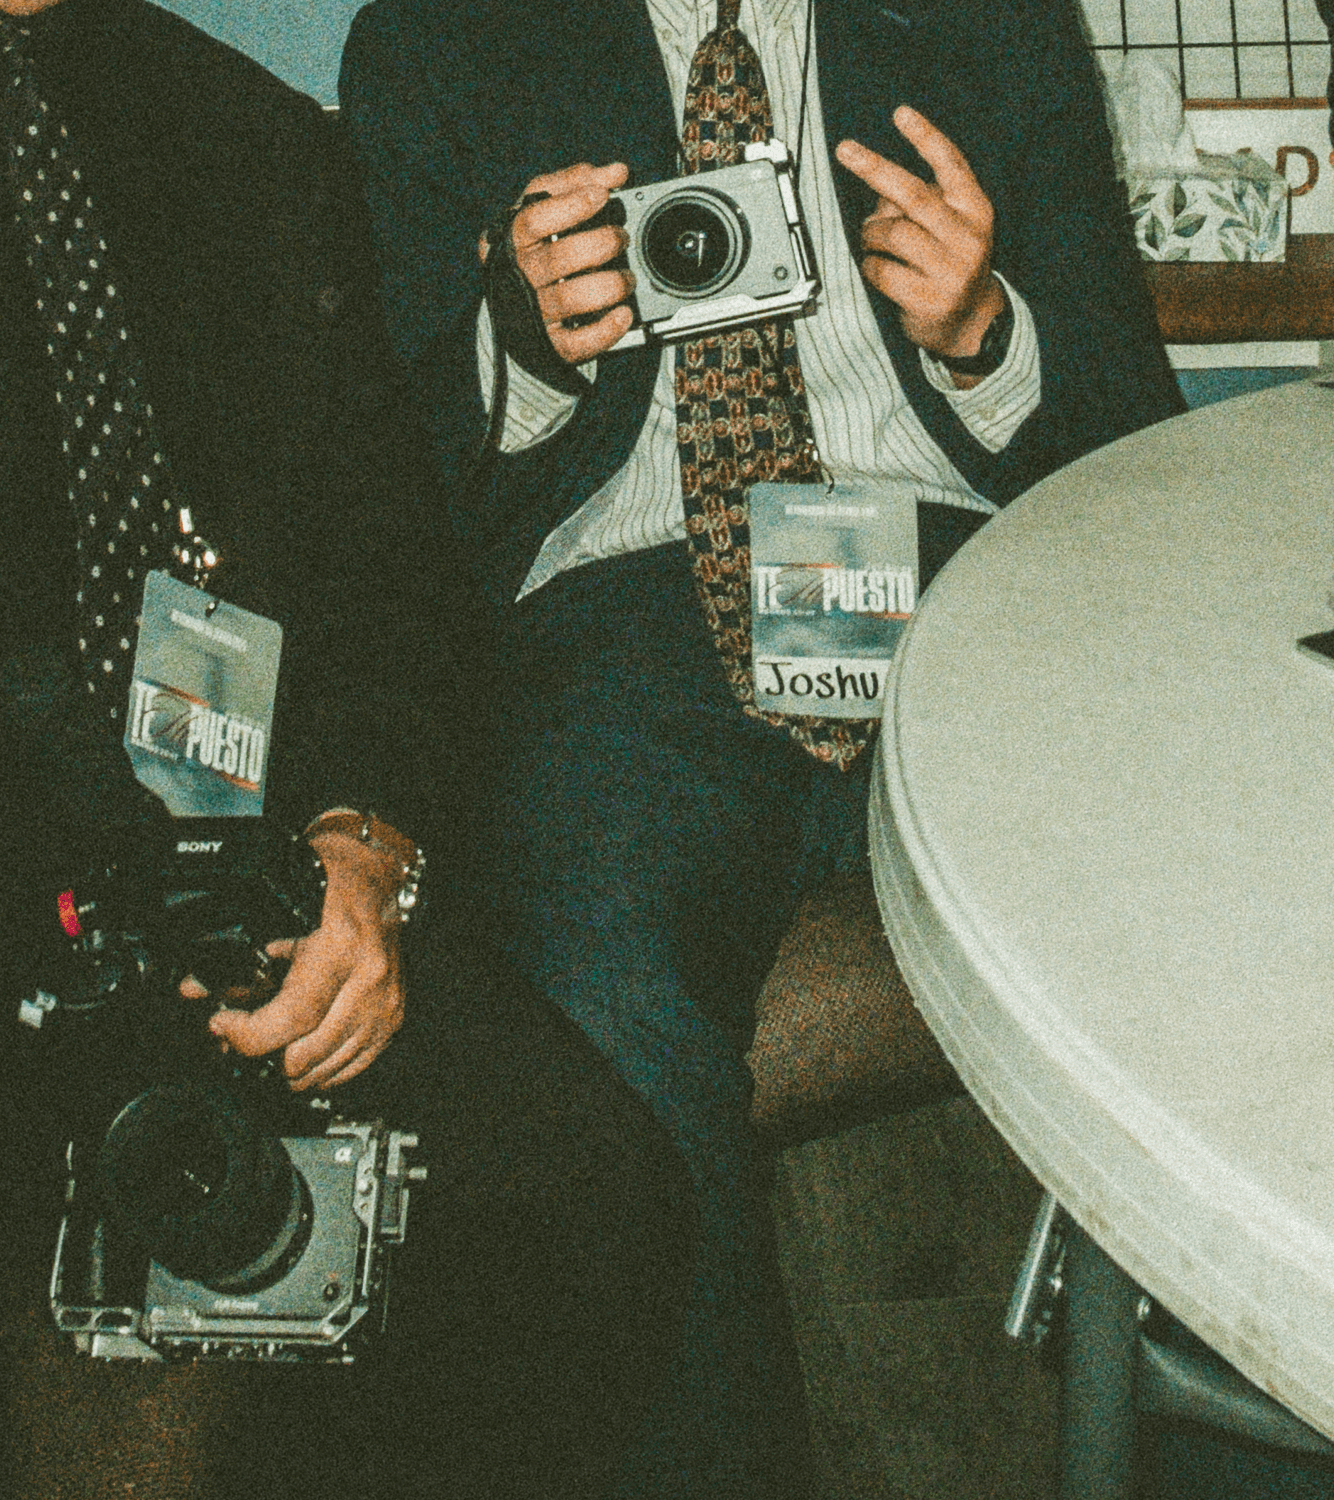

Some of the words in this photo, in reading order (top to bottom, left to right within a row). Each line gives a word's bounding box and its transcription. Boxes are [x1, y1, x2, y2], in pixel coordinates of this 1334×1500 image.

[821, 566, 915, 613] PUESTO
[185, 703, 266, 783] PUESTO
[176, 840, 223, 853] SONY
